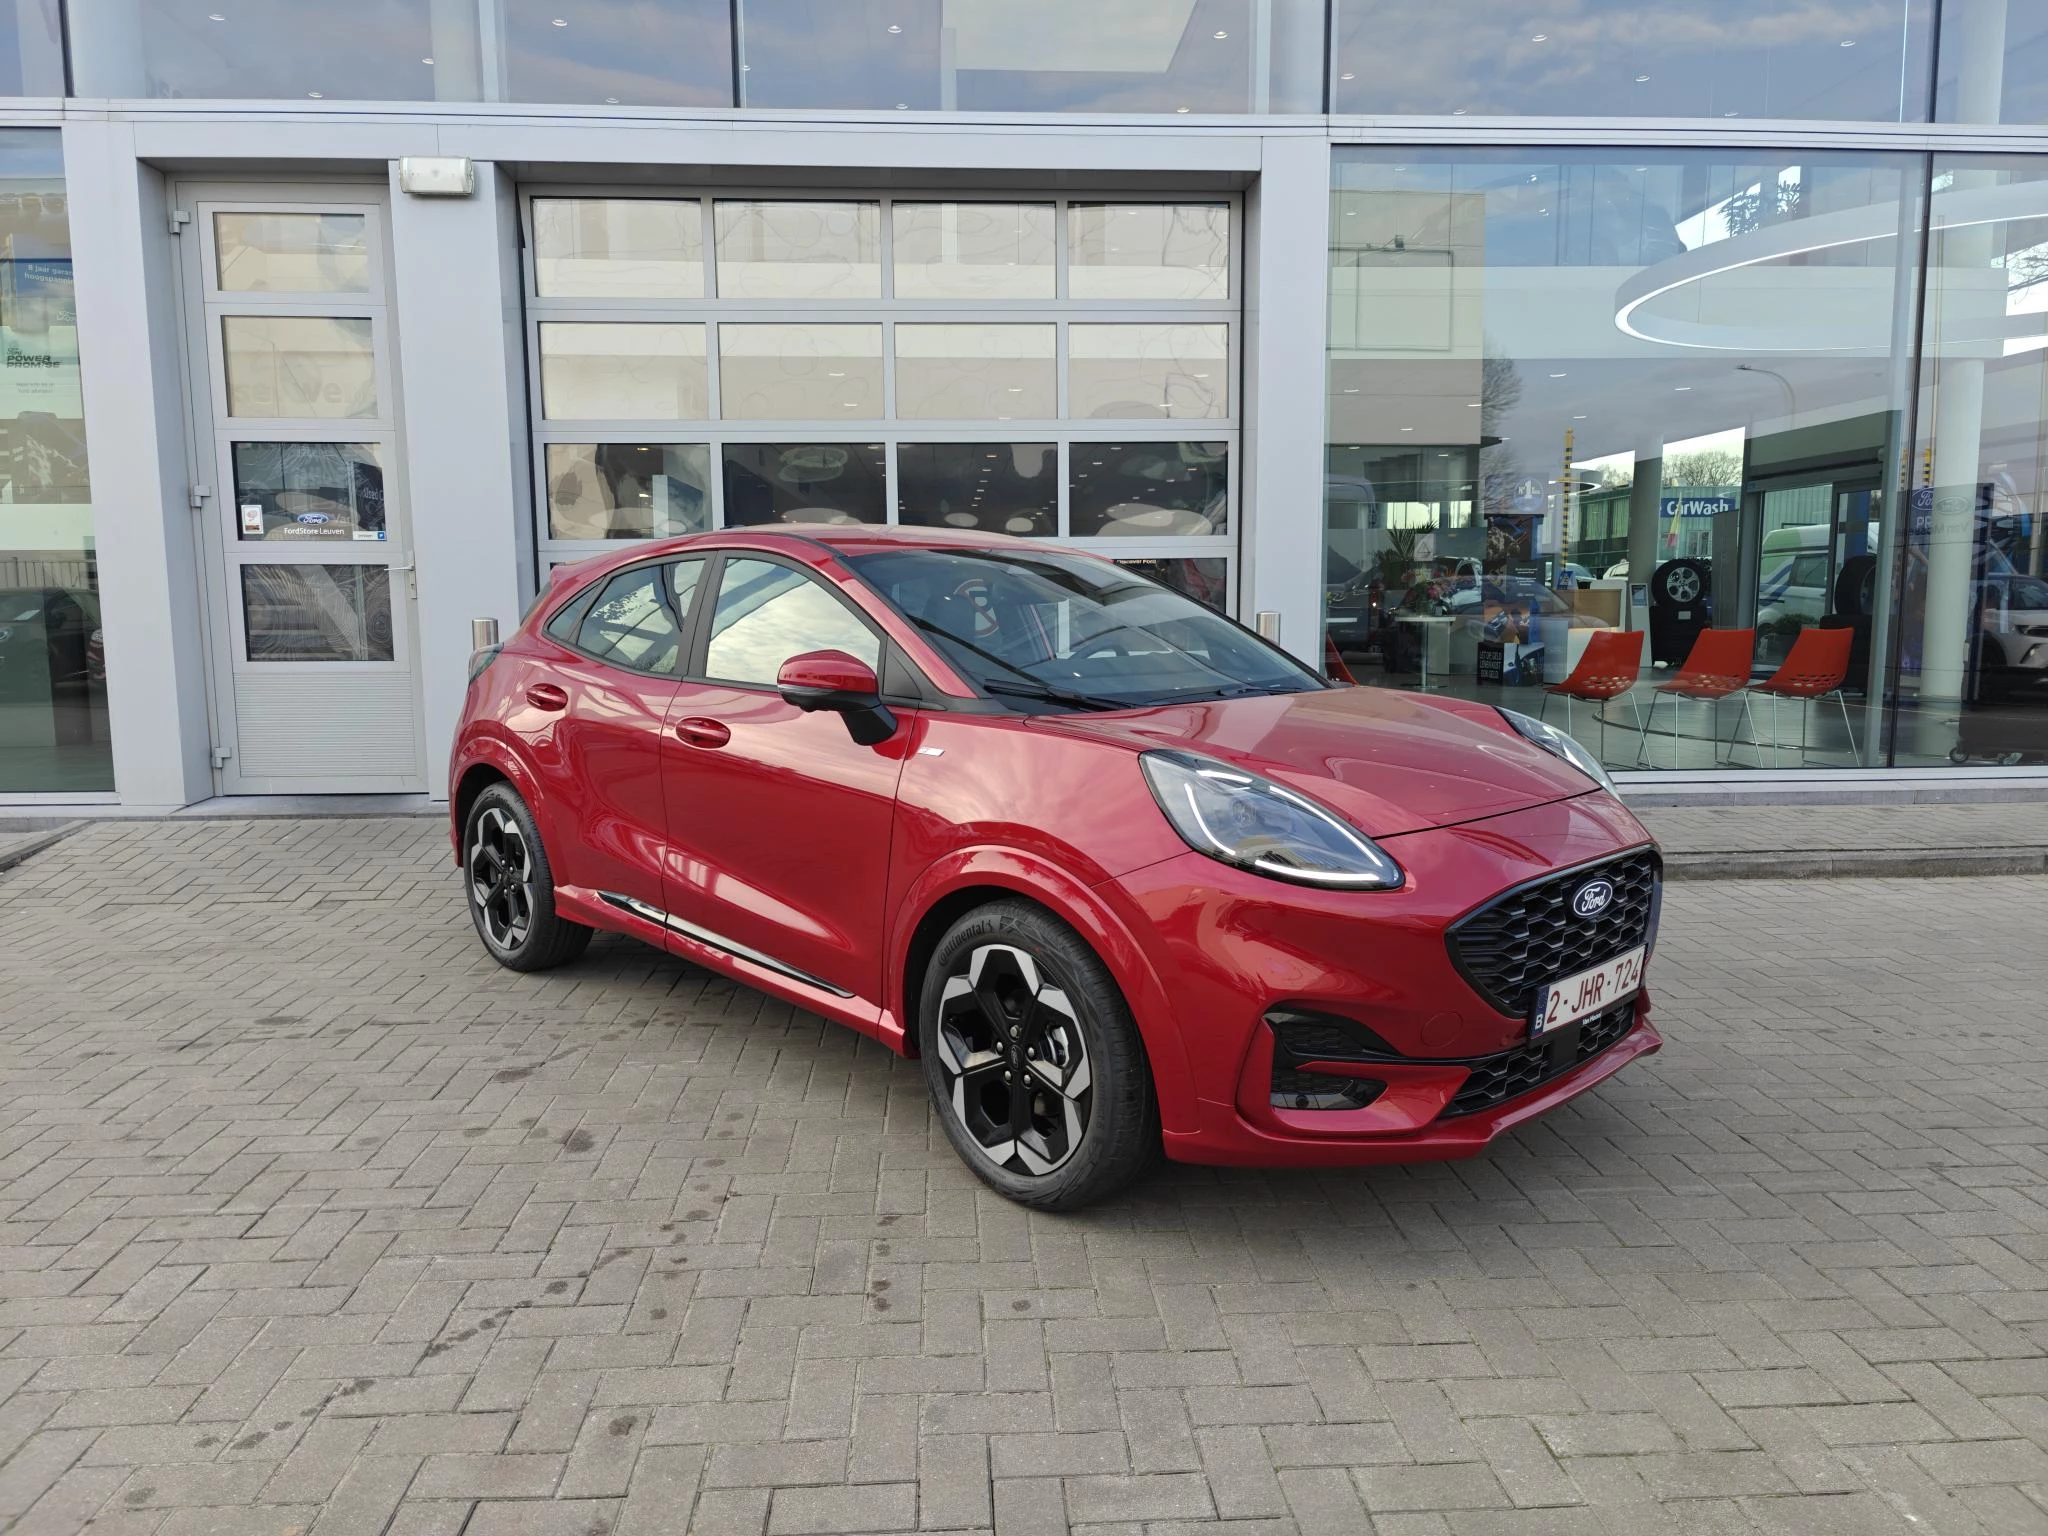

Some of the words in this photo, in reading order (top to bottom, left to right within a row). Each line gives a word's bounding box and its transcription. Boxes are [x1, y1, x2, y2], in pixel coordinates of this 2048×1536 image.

[283, 527, 319, 536] FordStore
[319, 527, 345, 536] Leuven
[1581, 886, 1607, 912] Ford
[1534, 1013, 1544, 1030] B
